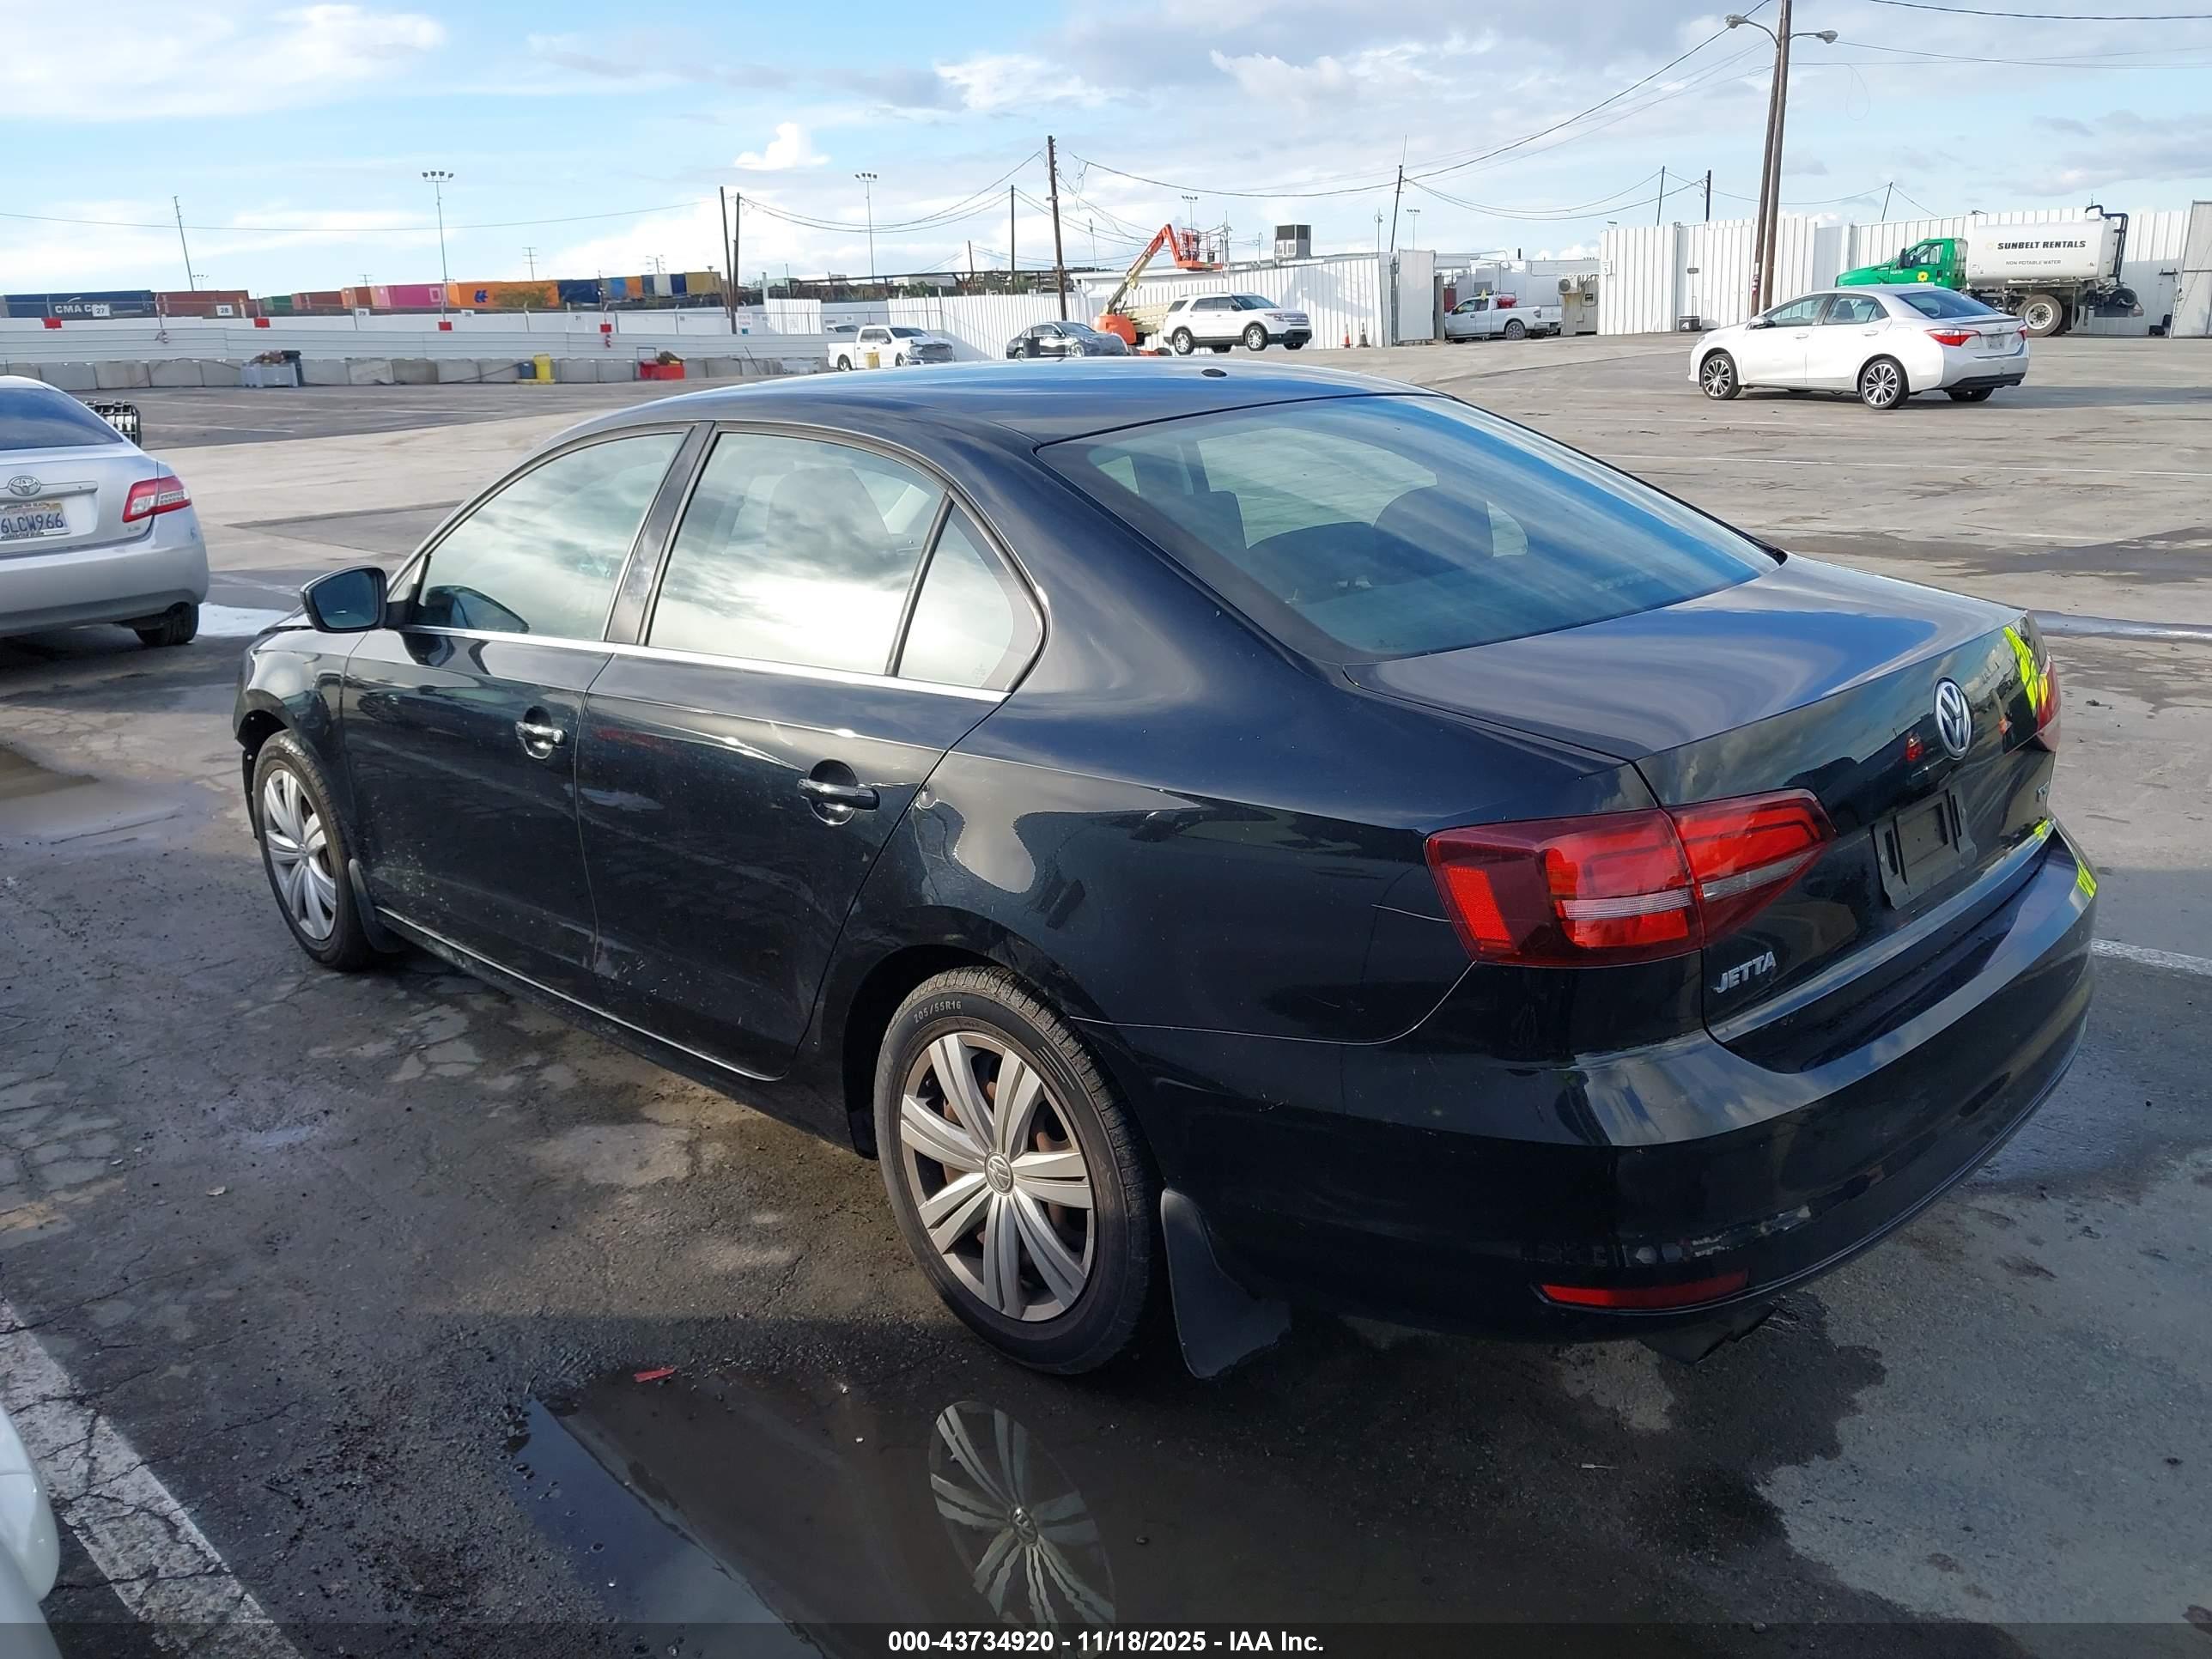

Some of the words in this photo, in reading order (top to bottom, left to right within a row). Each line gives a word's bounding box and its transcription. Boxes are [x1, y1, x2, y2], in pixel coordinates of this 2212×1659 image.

[1997, 241, 2040, 250] SUNBELT
[2043, 240, 2087, 249] RENTALS
[55, 304, 82, 313] CMA
[1, 513, 64, 534] 6LCW966
[1712, 951, 1777, 994] JETTA
[914, 1000, 962, 1024] 205/55R16
